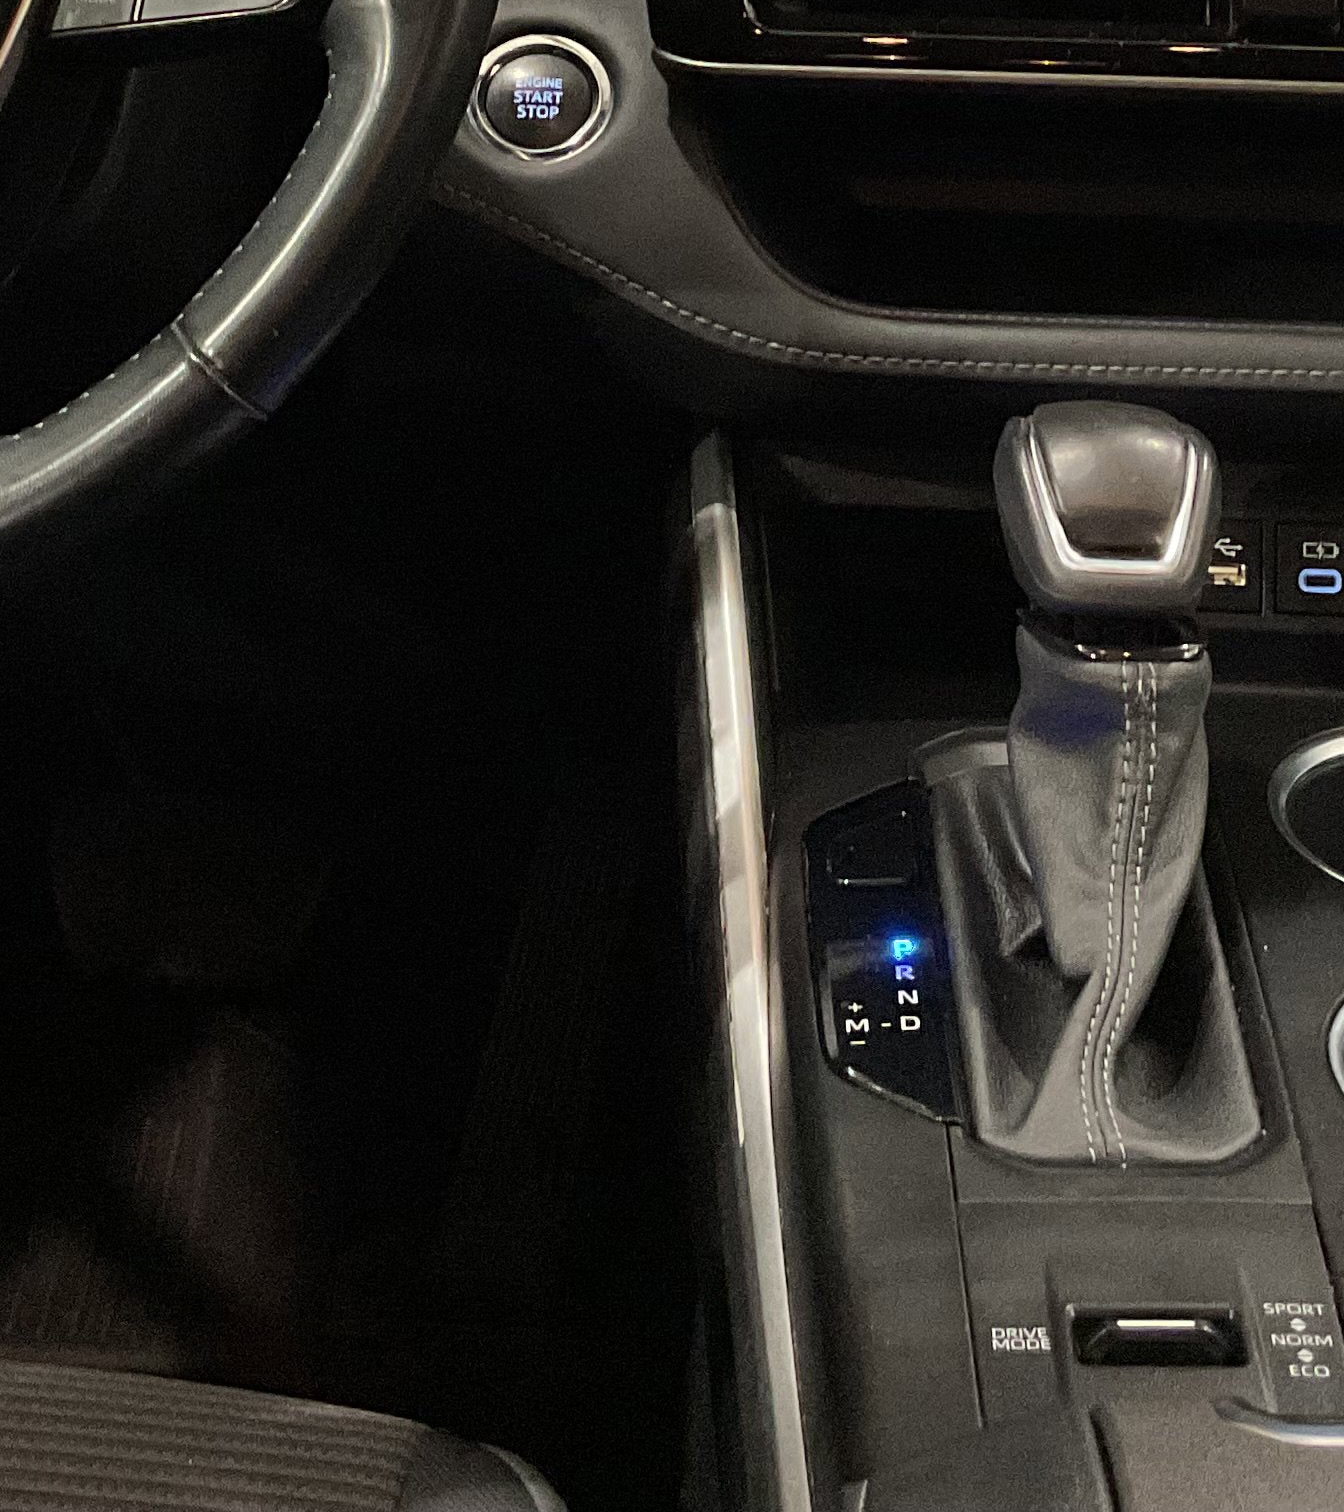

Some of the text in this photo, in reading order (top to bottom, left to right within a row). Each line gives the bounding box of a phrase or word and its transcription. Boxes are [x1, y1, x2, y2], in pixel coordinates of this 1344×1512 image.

[515, 77, 563, 88] ENGINE
[513, 90, 563, 104] START
[516, 104, 560, 119] STOP
[893, 939, 913, 960] P
[895, 965, 914, 980] R
[898, 989, 918, 1004] N
[846, 1019, 869, 1033] M
[900, 1016, 920, 1030] D
[1263, 1303, 1325, 1316] SPORT
[991, 1327, 1047, 1339] DRIVE
[1271, 1333, 1333, 1347] NORM
[992, 1338, 1051, 1351] MODE
[1289, 1365, 1330, 1377] ECO
